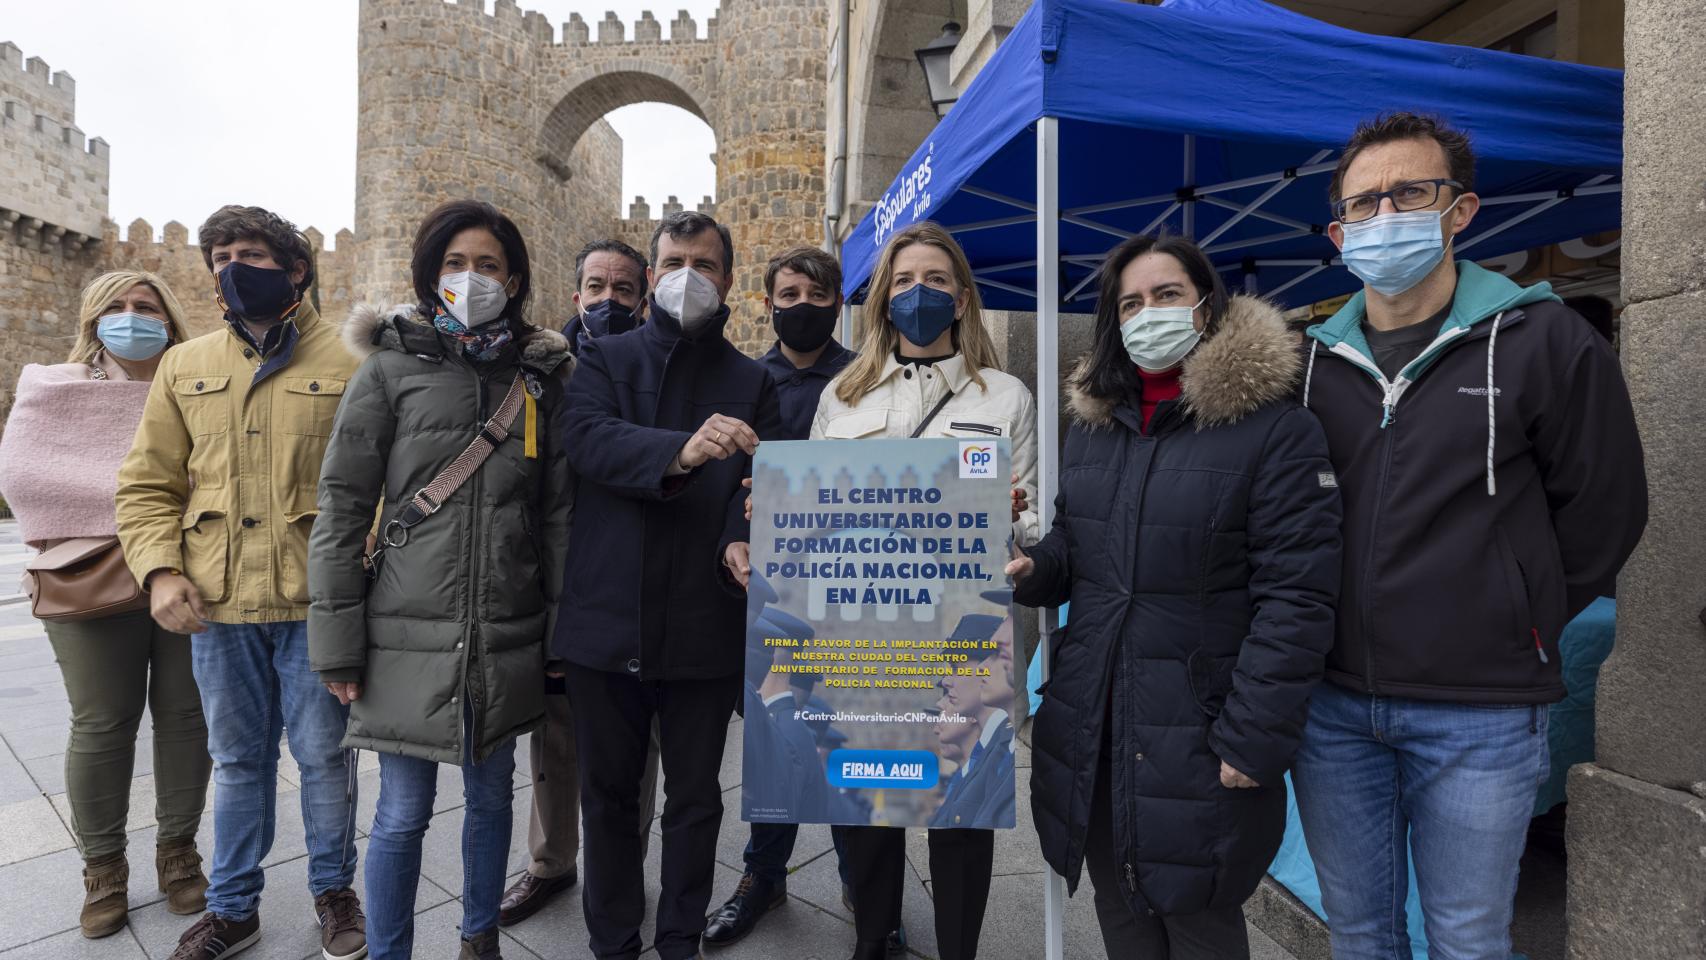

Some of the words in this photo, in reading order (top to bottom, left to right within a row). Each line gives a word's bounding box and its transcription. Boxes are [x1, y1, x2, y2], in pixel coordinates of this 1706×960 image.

[818, 488, 844, 504] EL
[848, 487, 942, 504] CENTRO
[774, 512, 953, 529] UNIVERSITARIO
[958, 512, 989, 529] DE
[775, 532, 917, 554] FORMACIÓN
[922, 537, 953, 554] DE
[958, 537, 987, 554] LA
[766, 557, 858, 579] POLICÍA
[862, 562, 993, 582] NACIONAL,
[826, 587, 857, 604] EN
[861, 582, 933, 605] ÁVILA
[764, 638, 799, 648] FIRMA
[802, 639, 811, 648] A
[813, 639, 852, 649] FAVOR
[855, 640, 870, 649] DE
[873, 640, 888, 649] LA
[891, 640, 978, 650] IMPLANTACIÓN
[982, 641, 998, 649] EN
[792, 652, 846, 661] NUESTRA
[849, 653, 893, 662] CIUDAD
[896, 653, 918, 662] DEL
[921, 654, 968, 663] CENTRO
[771, 665, 860, 674] UNIVERSITARIO
[863, 666, 879, 675] DE
[957, 667, 973, 676] DE
[976, 668, 991, 676] LA
[875, 680, 935, 690] NACIONAL
[794, 710, 967, 724] #CentroUniversitarioCNPenÁvila
[843, 762, 885, 777] FIRMA
[890, 763, 923, 778] AQUI
